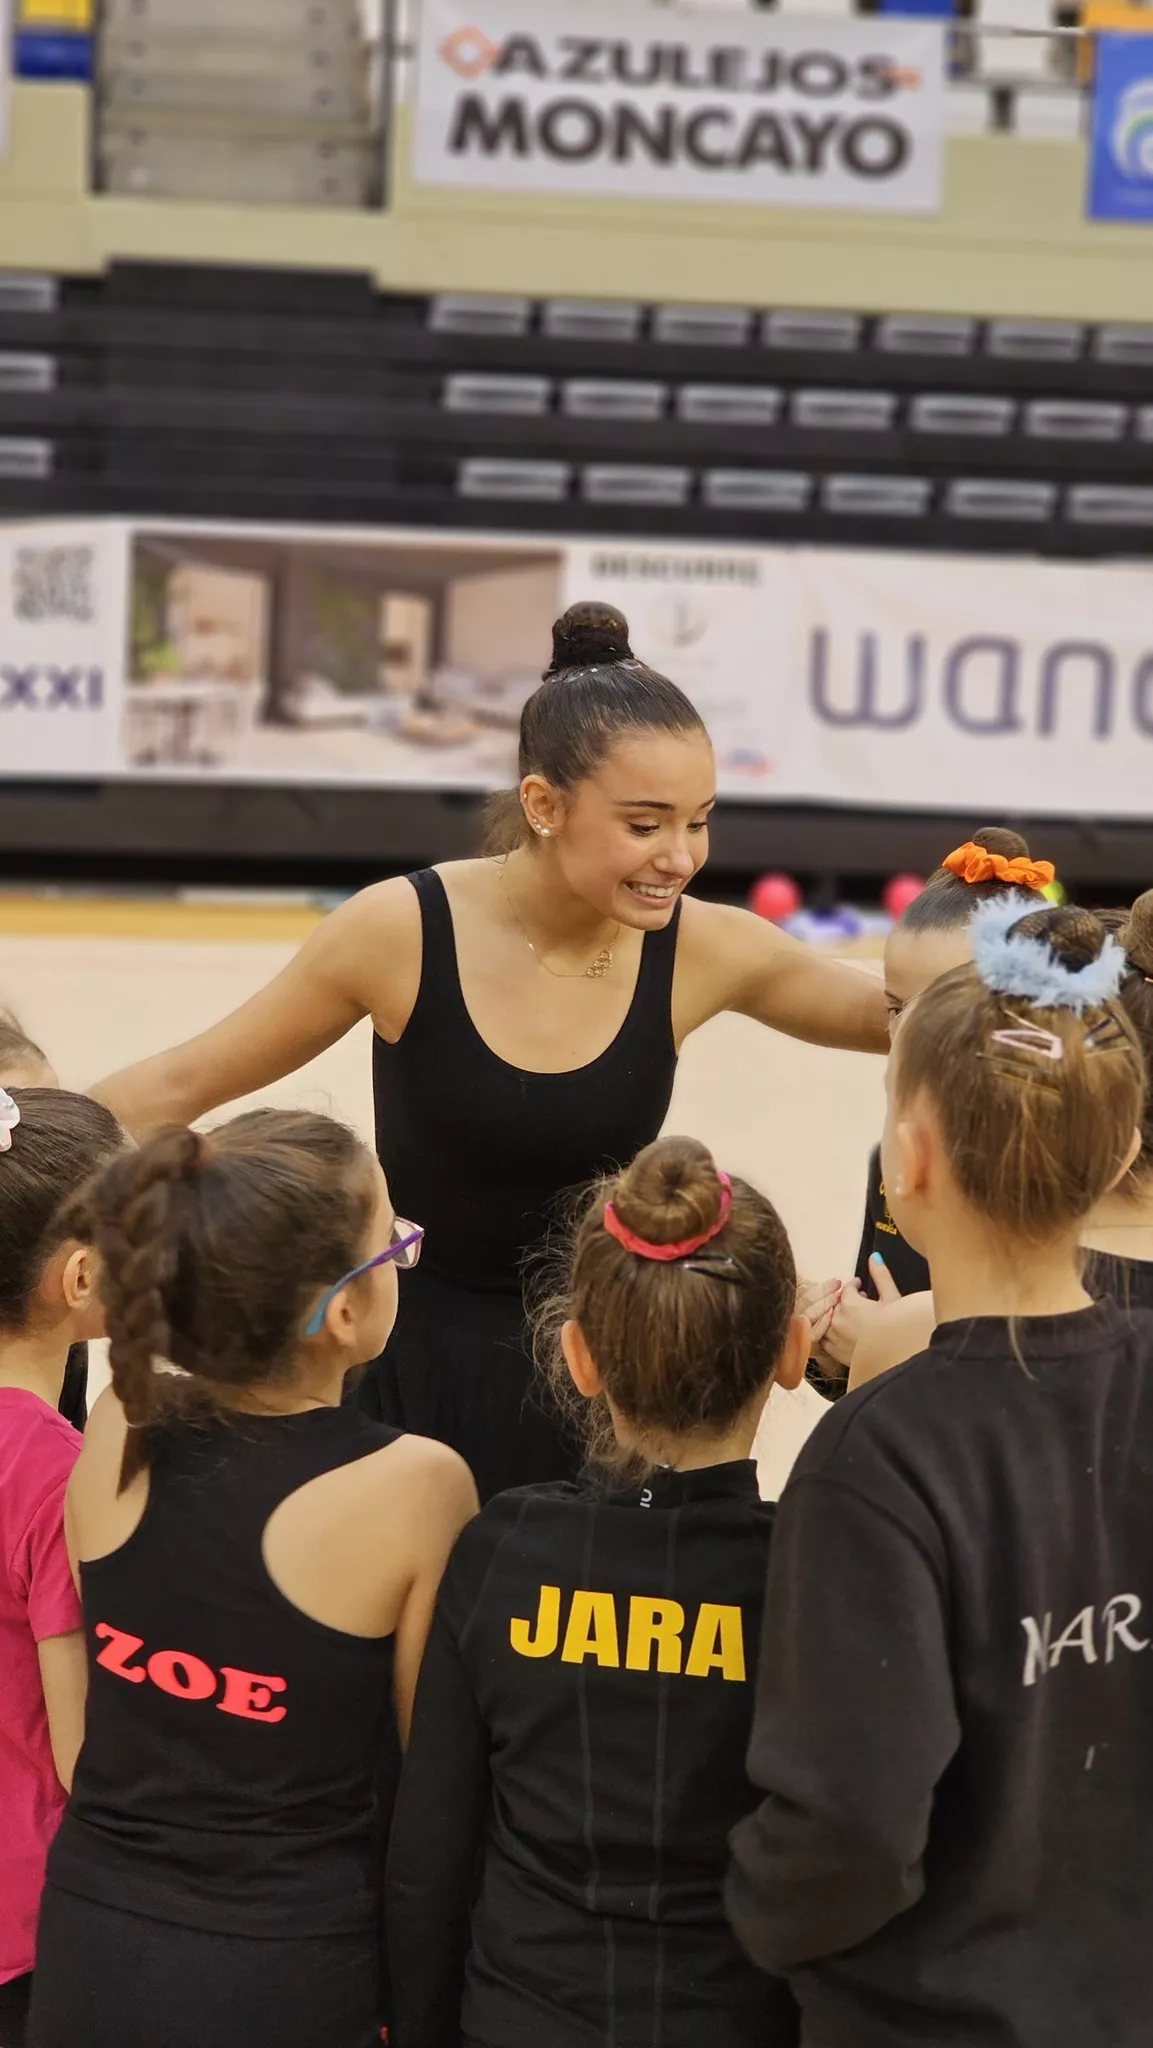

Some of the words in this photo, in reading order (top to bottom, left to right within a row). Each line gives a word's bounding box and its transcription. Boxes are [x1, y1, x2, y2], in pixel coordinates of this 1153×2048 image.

[492, 33, 901, 101] AZULEJOS
[446, 93, 913, 181] MONCAYO
[94, 1621, 288, 1723] ZOE
[509, 1584, 747, 1682] JARA
[1019, 1592, 1153, 1687] MAR
